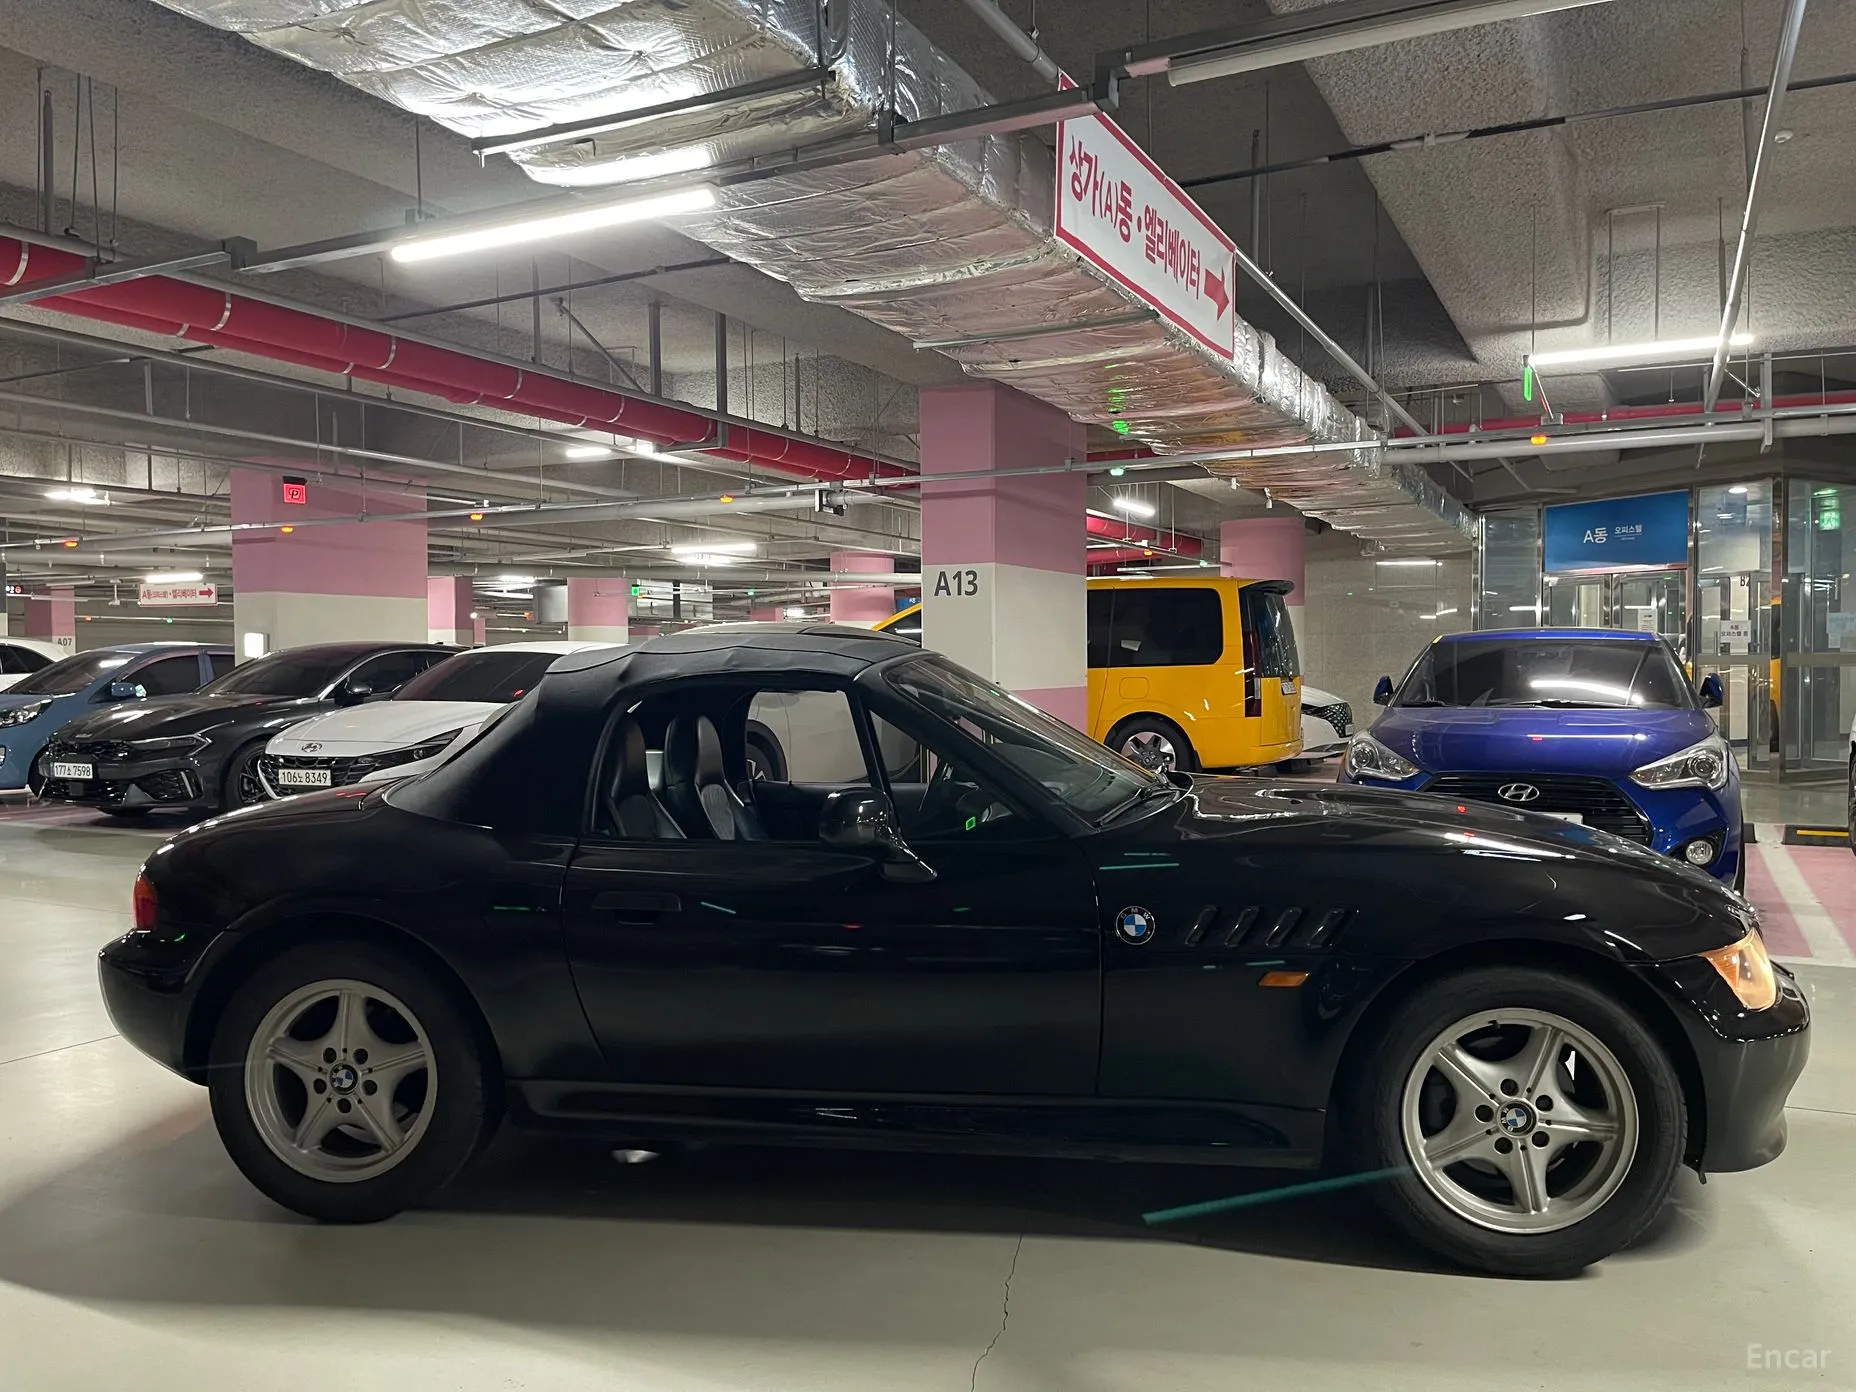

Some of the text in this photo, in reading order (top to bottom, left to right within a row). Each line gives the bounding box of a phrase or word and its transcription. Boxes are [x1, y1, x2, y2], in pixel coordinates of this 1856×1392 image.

[1583, 524, 1643, 544] A동 오피스텔
[934, 570, 978, 597] A13
[57, 637, 72, 647] A07
[73, 765, 91, 777] 7598
[305, 771, 328, 784] 8349
